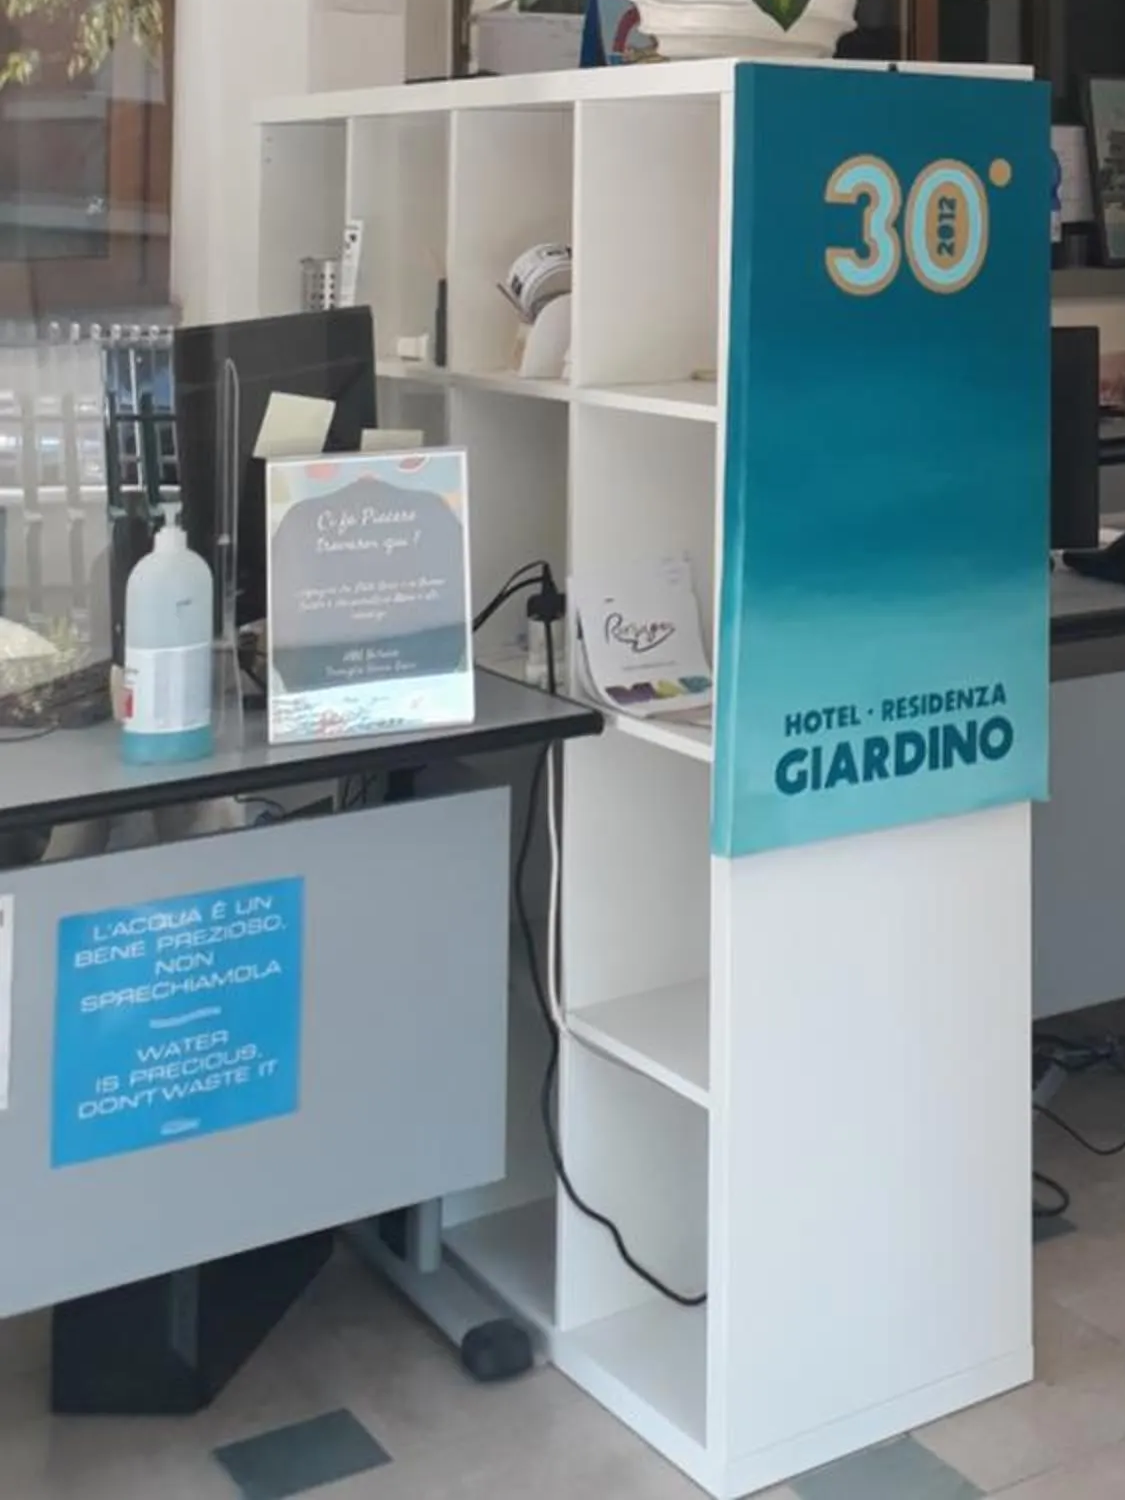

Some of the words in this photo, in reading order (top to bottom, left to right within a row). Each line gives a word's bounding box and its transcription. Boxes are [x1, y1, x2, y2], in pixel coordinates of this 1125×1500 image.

[784, 704, 861, 738] HOTEL
[881, 682, 1007, 722] RESIDENZA
[774, 715, 1014, 796] GIARDINO
[93, 906, 202, 942] L'ACQUA
[235, 896, 274, 916] UN
[73, 939, 147, 969] BENE
[154, 950, 215, 976] NON
[80, 959, 283, 1013] SPRECHIAMOLA
[136, 1029, 229, 1063] WATER
[95, 1075, 120, 1094] IS
[161, 1065, 252, 1101] WASTE
[257, 1058, 279, 1077] IT
